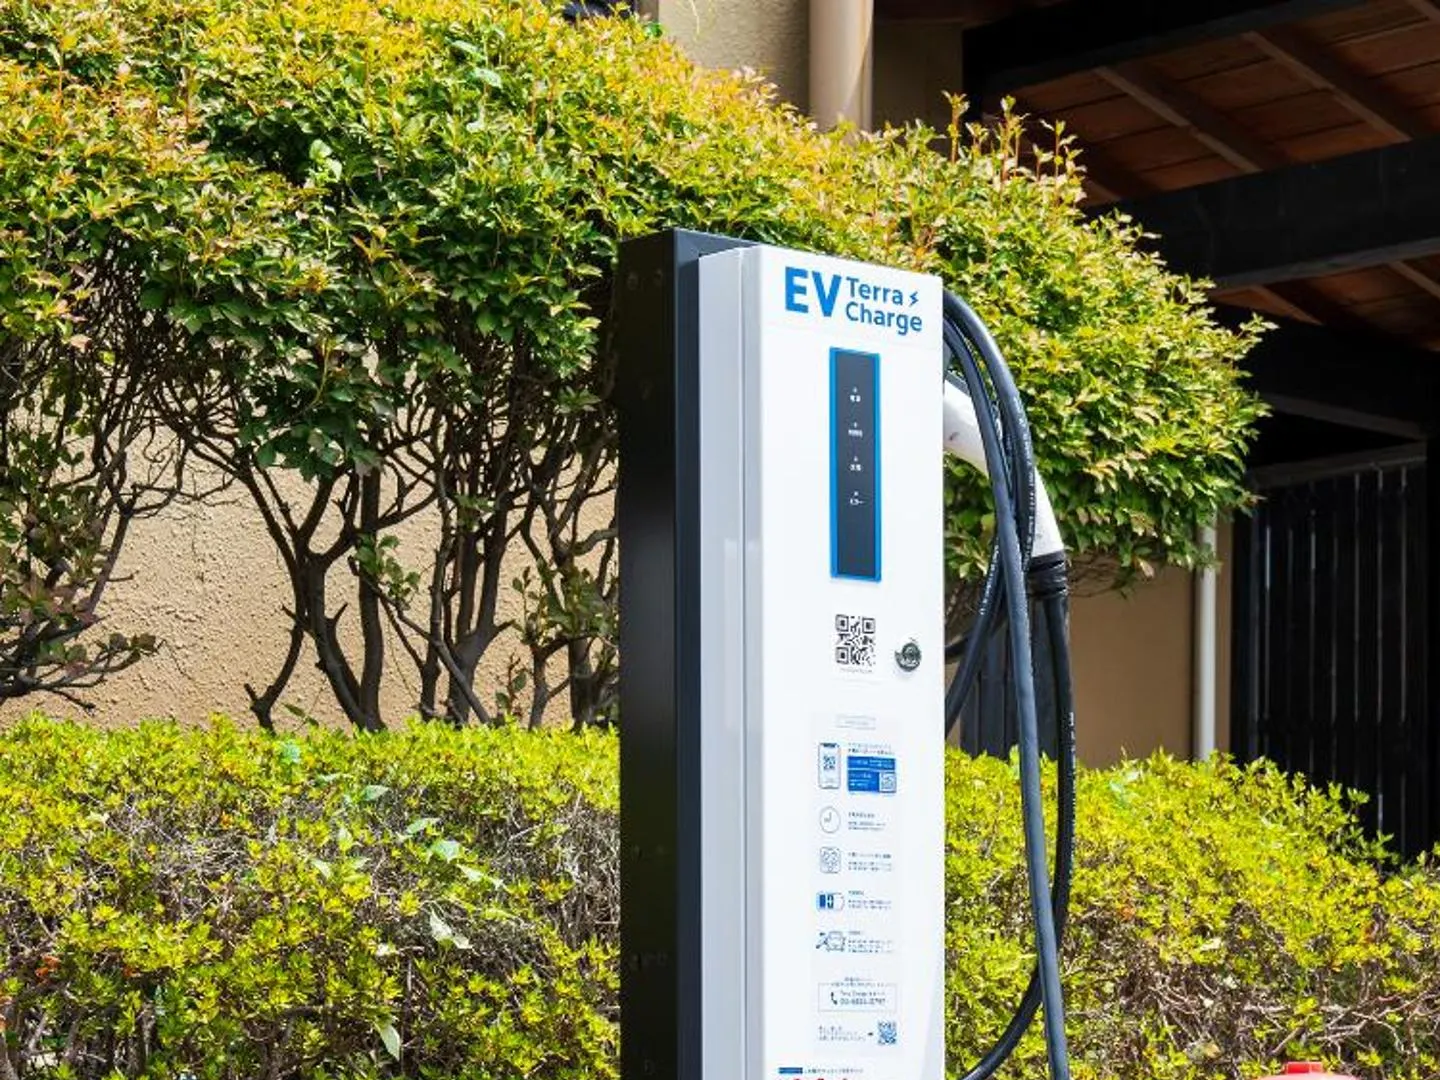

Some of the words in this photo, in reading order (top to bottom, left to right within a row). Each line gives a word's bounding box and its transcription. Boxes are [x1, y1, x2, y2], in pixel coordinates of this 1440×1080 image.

[785, 266, 842, 317] EV
[846, 276, 904, 305] Terra
[845, 301, 923, 336] Charge
